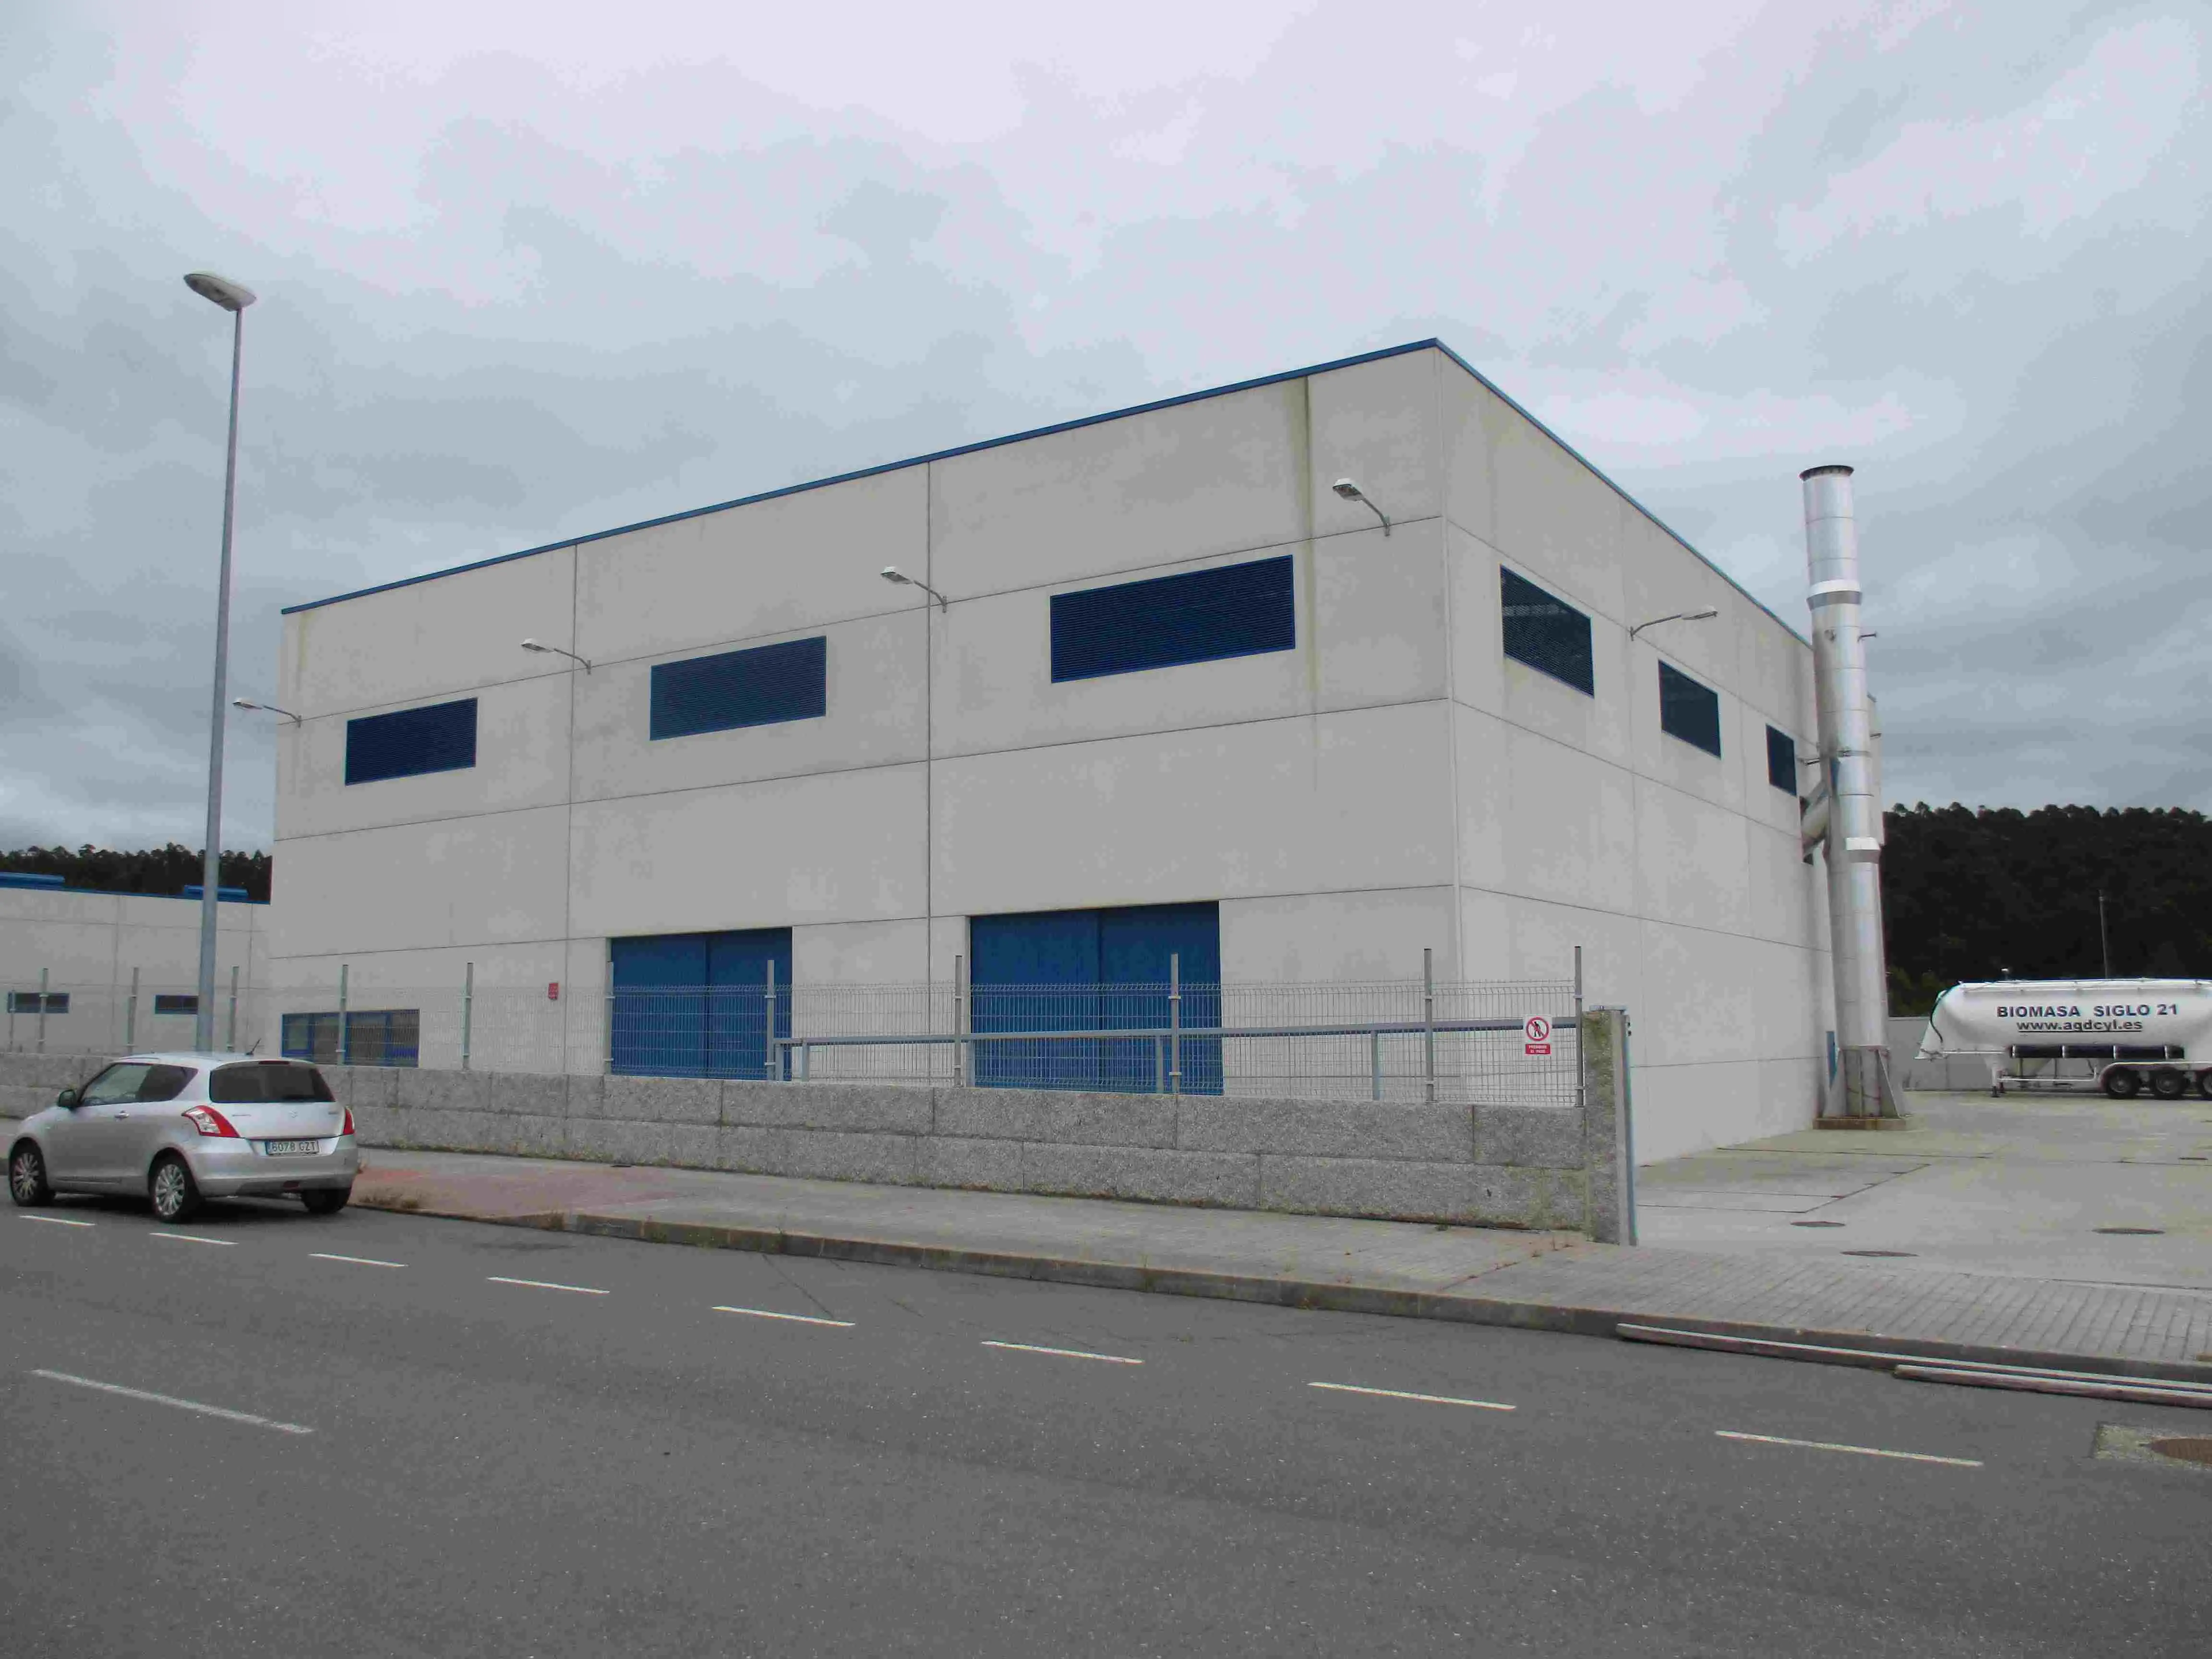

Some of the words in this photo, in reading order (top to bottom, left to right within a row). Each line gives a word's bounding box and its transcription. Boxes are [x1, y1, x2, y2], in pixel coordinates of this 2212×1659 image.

[1997, 1006, 2081, 1018] BIOMASA
[2093, 1004, 2151, 1017] SIGLO
[2157, 1004, 2177, 1015] 21
[299, 1142, 315, 1151] GZT
